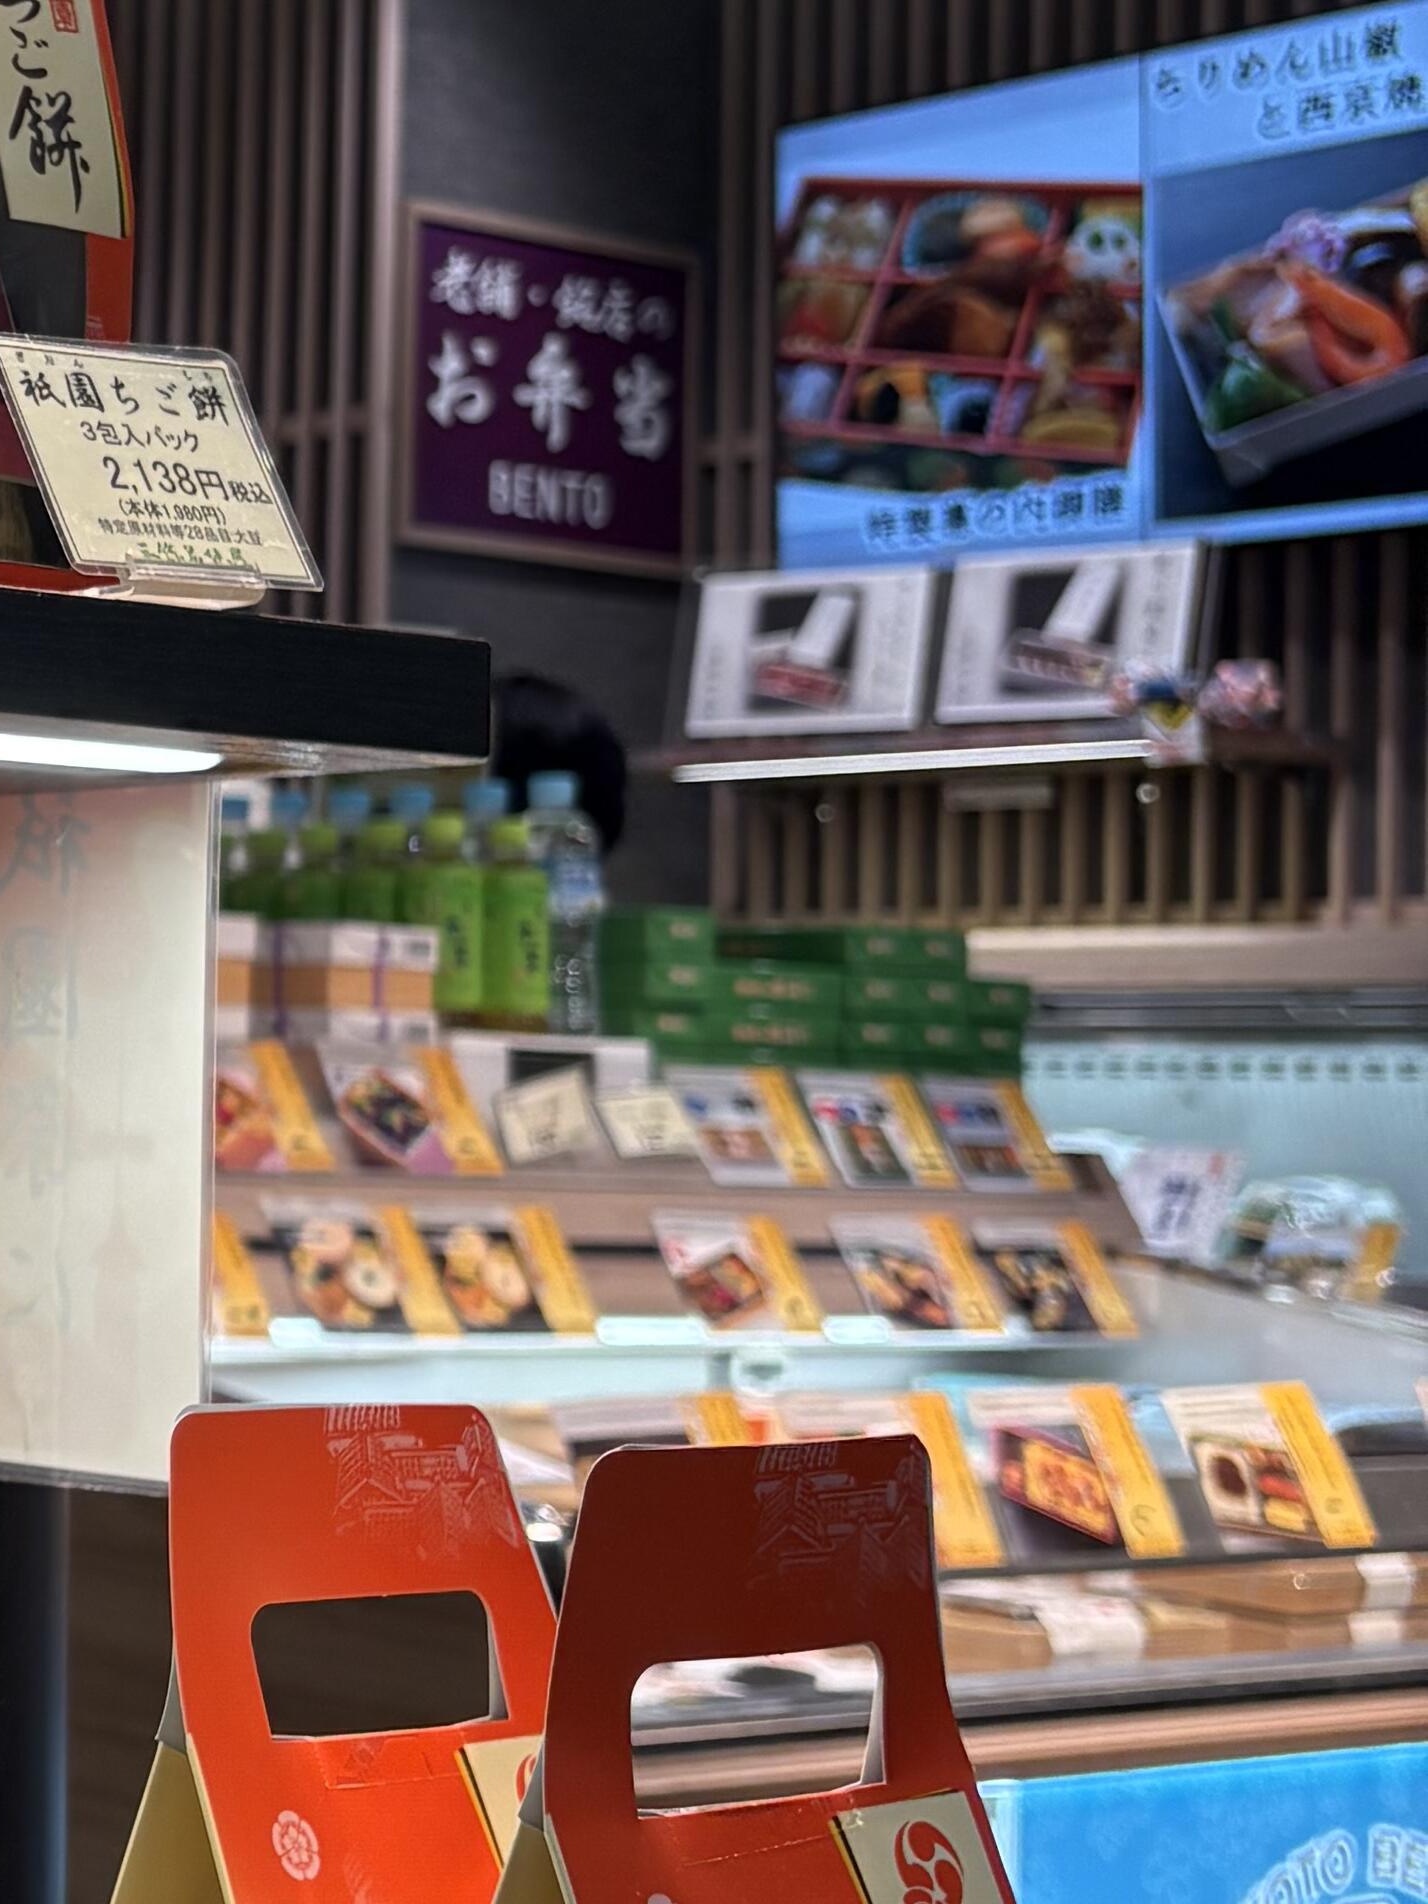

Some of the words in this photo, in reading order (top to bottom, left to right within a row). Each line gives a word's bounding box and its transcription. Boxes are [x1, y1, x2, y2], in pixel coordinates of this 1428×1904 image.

[19, 370, 230, 427] 祇園ちご餅
[79, 420, 200, 453] 3包入パック
[488, 458, 614, 530] BENTO
